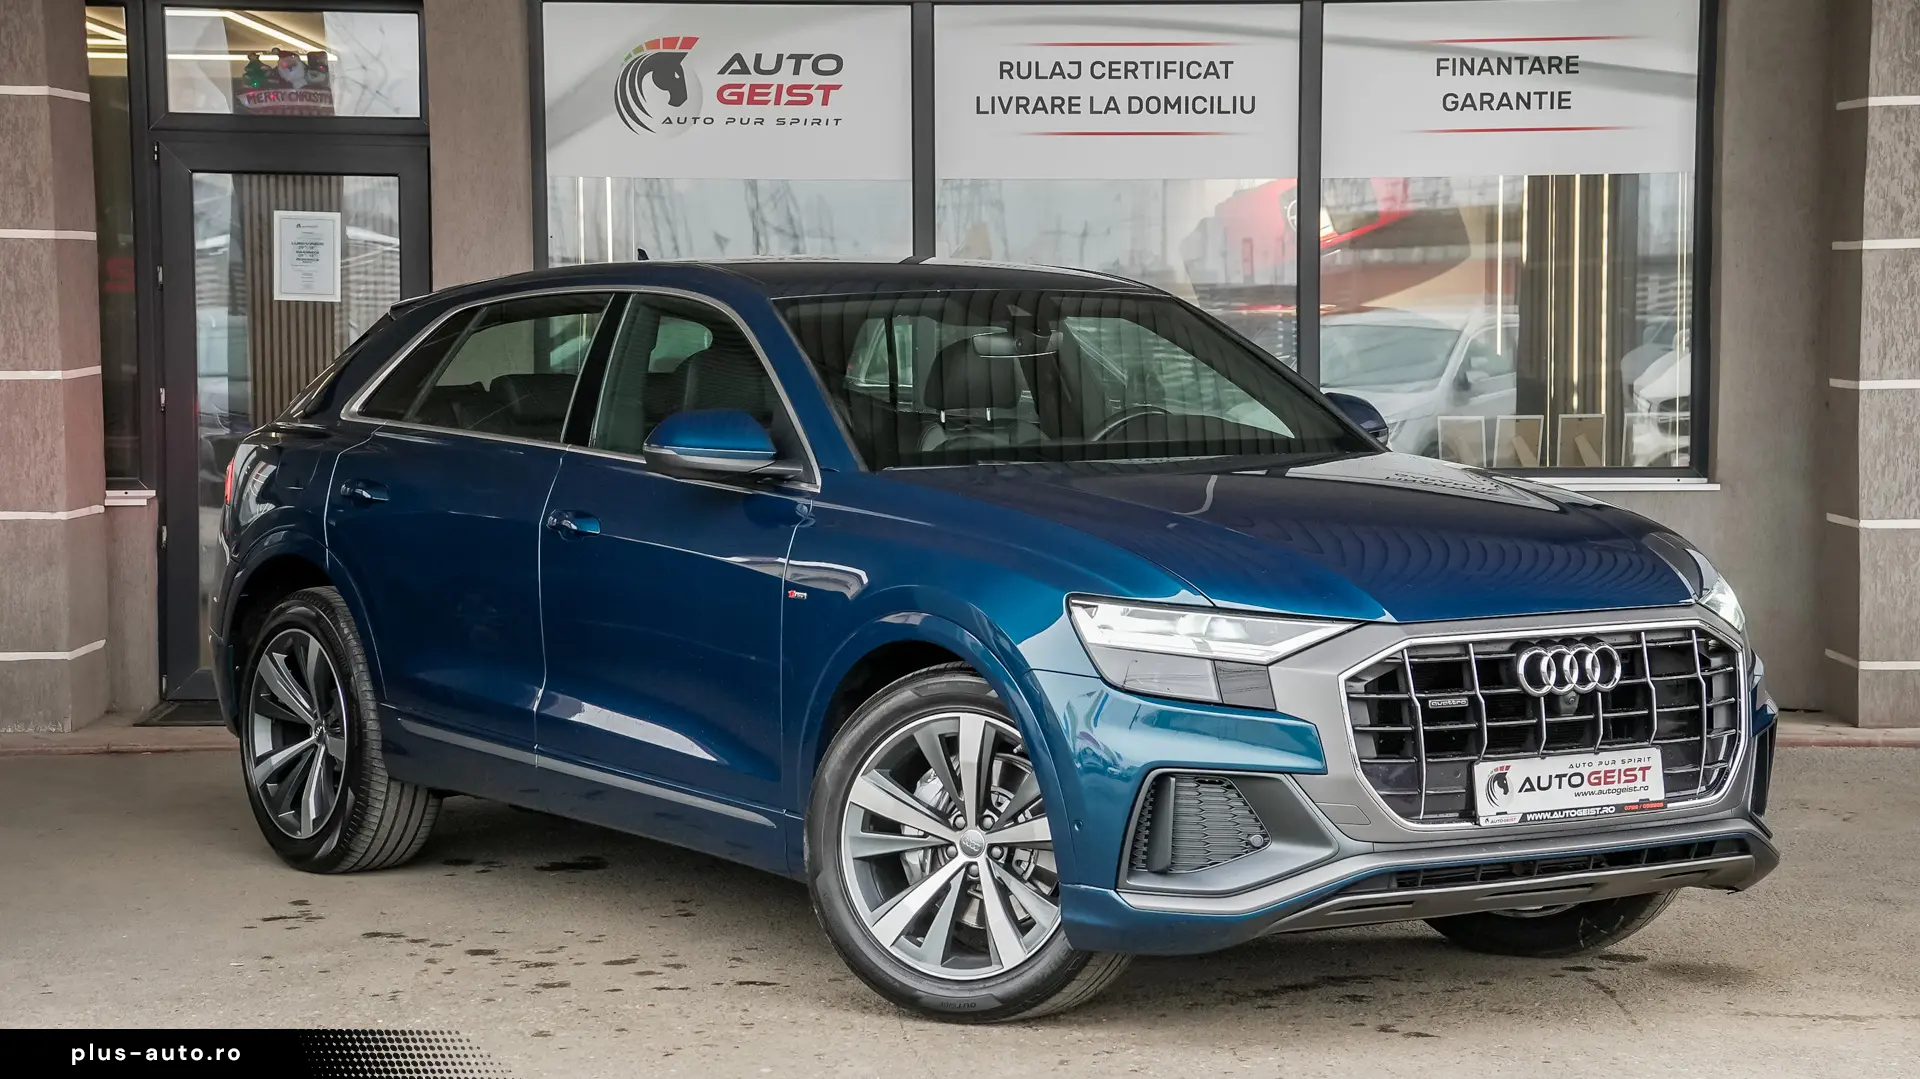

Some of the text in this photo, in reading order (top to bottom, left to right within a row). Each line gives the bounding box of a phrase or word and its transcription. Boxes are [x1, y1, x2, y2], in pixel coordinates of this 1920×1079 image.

[716, 52, 844, 77] AUTO
[999, 60, 1235, 80] RULAJ CERTIFICAT
[1436, 55, 1580, 77] FINANTARE
[245, 91, 286, 105] MERRY
[716, 83, 844, 107] GEIST
[1442, 91, 1572, 112] GARANTIE
[975, 95, 1256, 115] LIVRARE LA DOMICILIU
[661, 116, 843, 127] AUTO PUR SPIRIT
[1430, 699, 1467, 707] quattro
[1568, 756, 1652, 769] AUTO PUR SPIRIT
[1574, 785, 1649, 798] www.autogeist.ro
[1526, 805, 1616, 822] WWW.AUTOGEIST.RO
